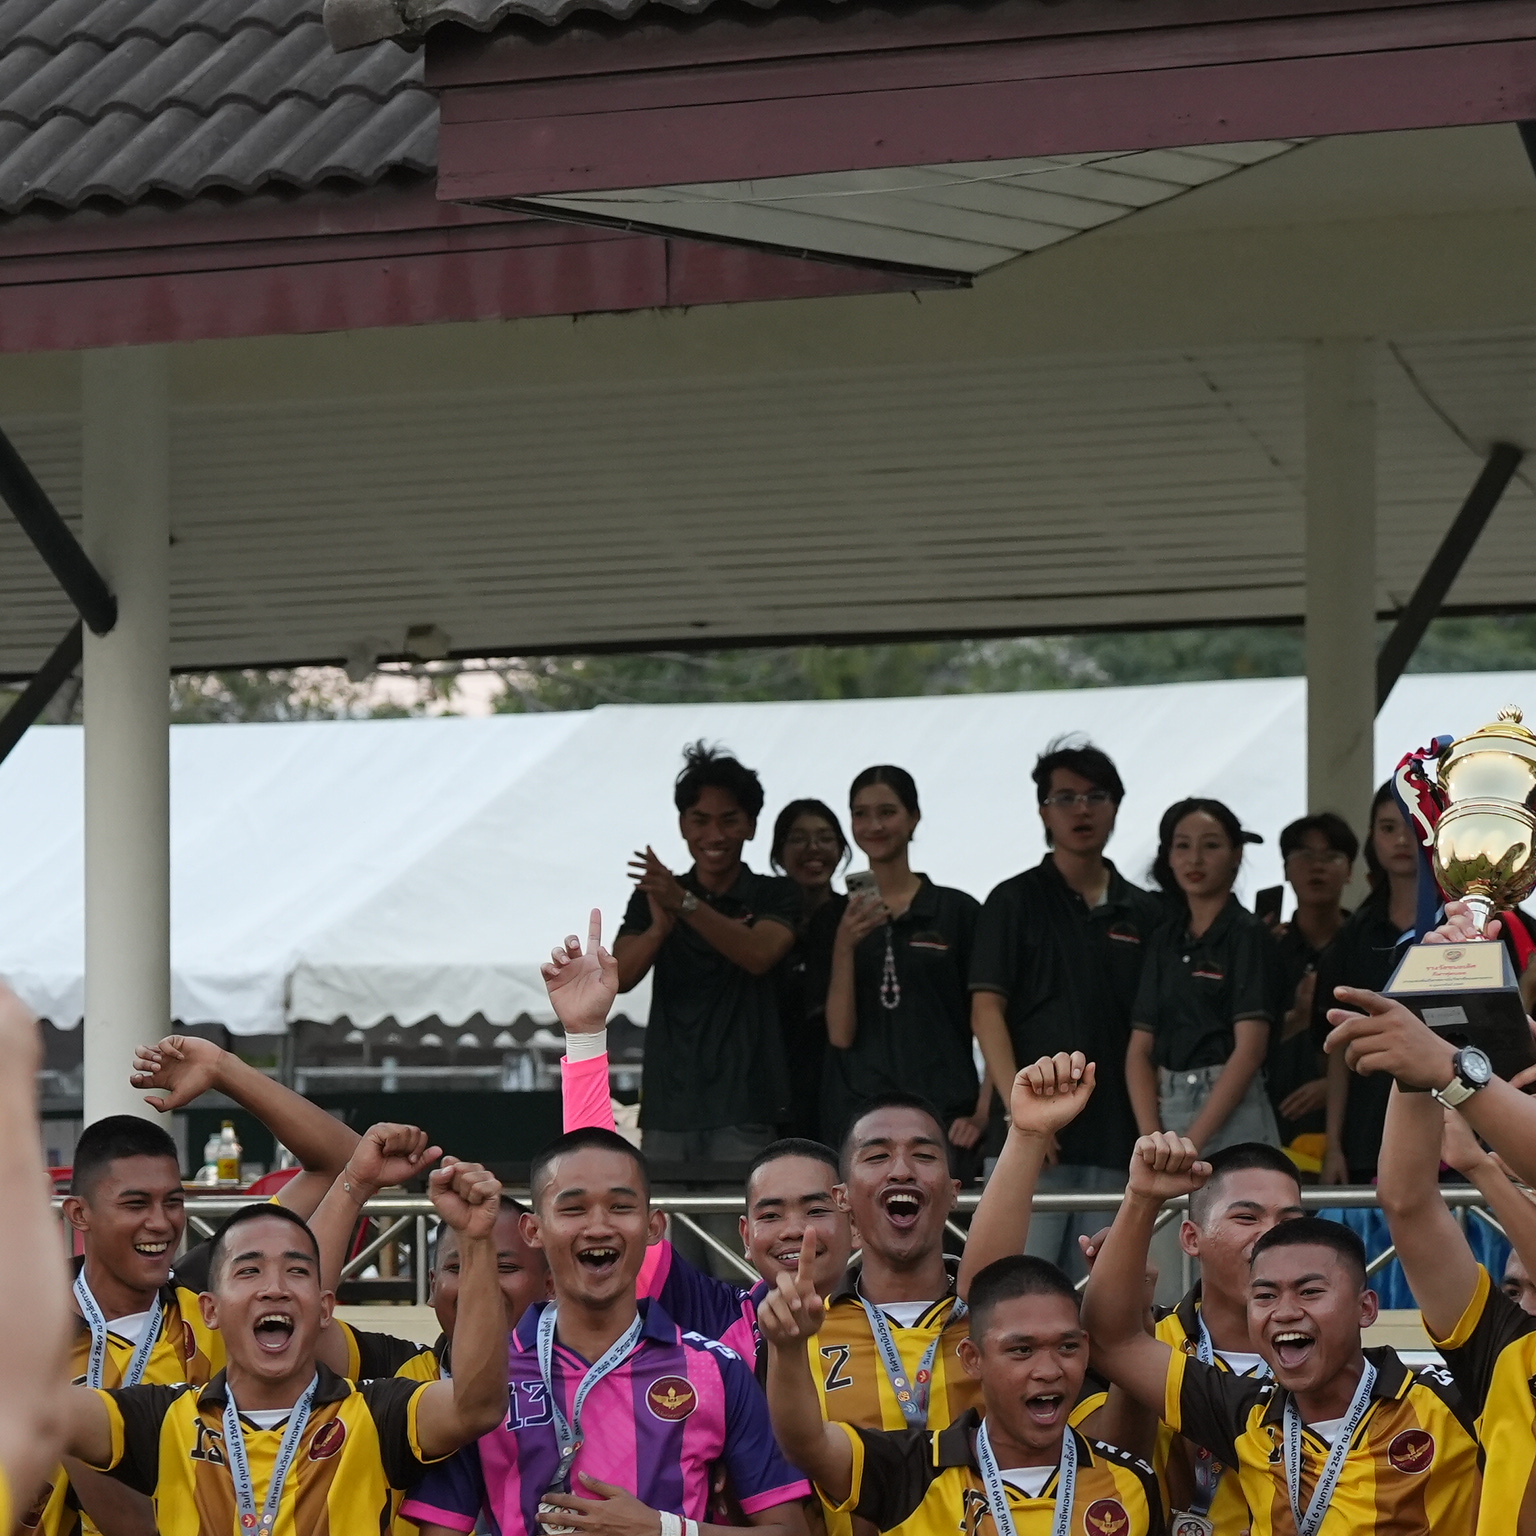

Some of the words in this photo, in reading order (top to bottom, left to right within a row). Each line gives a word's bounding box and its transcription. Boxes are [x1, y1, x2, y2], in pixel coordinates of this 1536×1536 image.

[819, 1343, 853, 1392] 2
[228, 1419, 238, 1440] 2569
[1312, 1467, 1339, 1512] กุมภาพันธ์
[1330, 1444, 1346, 1468] 2569
[239, 1491, 253, 1510] วันที่
[992, 1489, 1006, 1512] 2569
